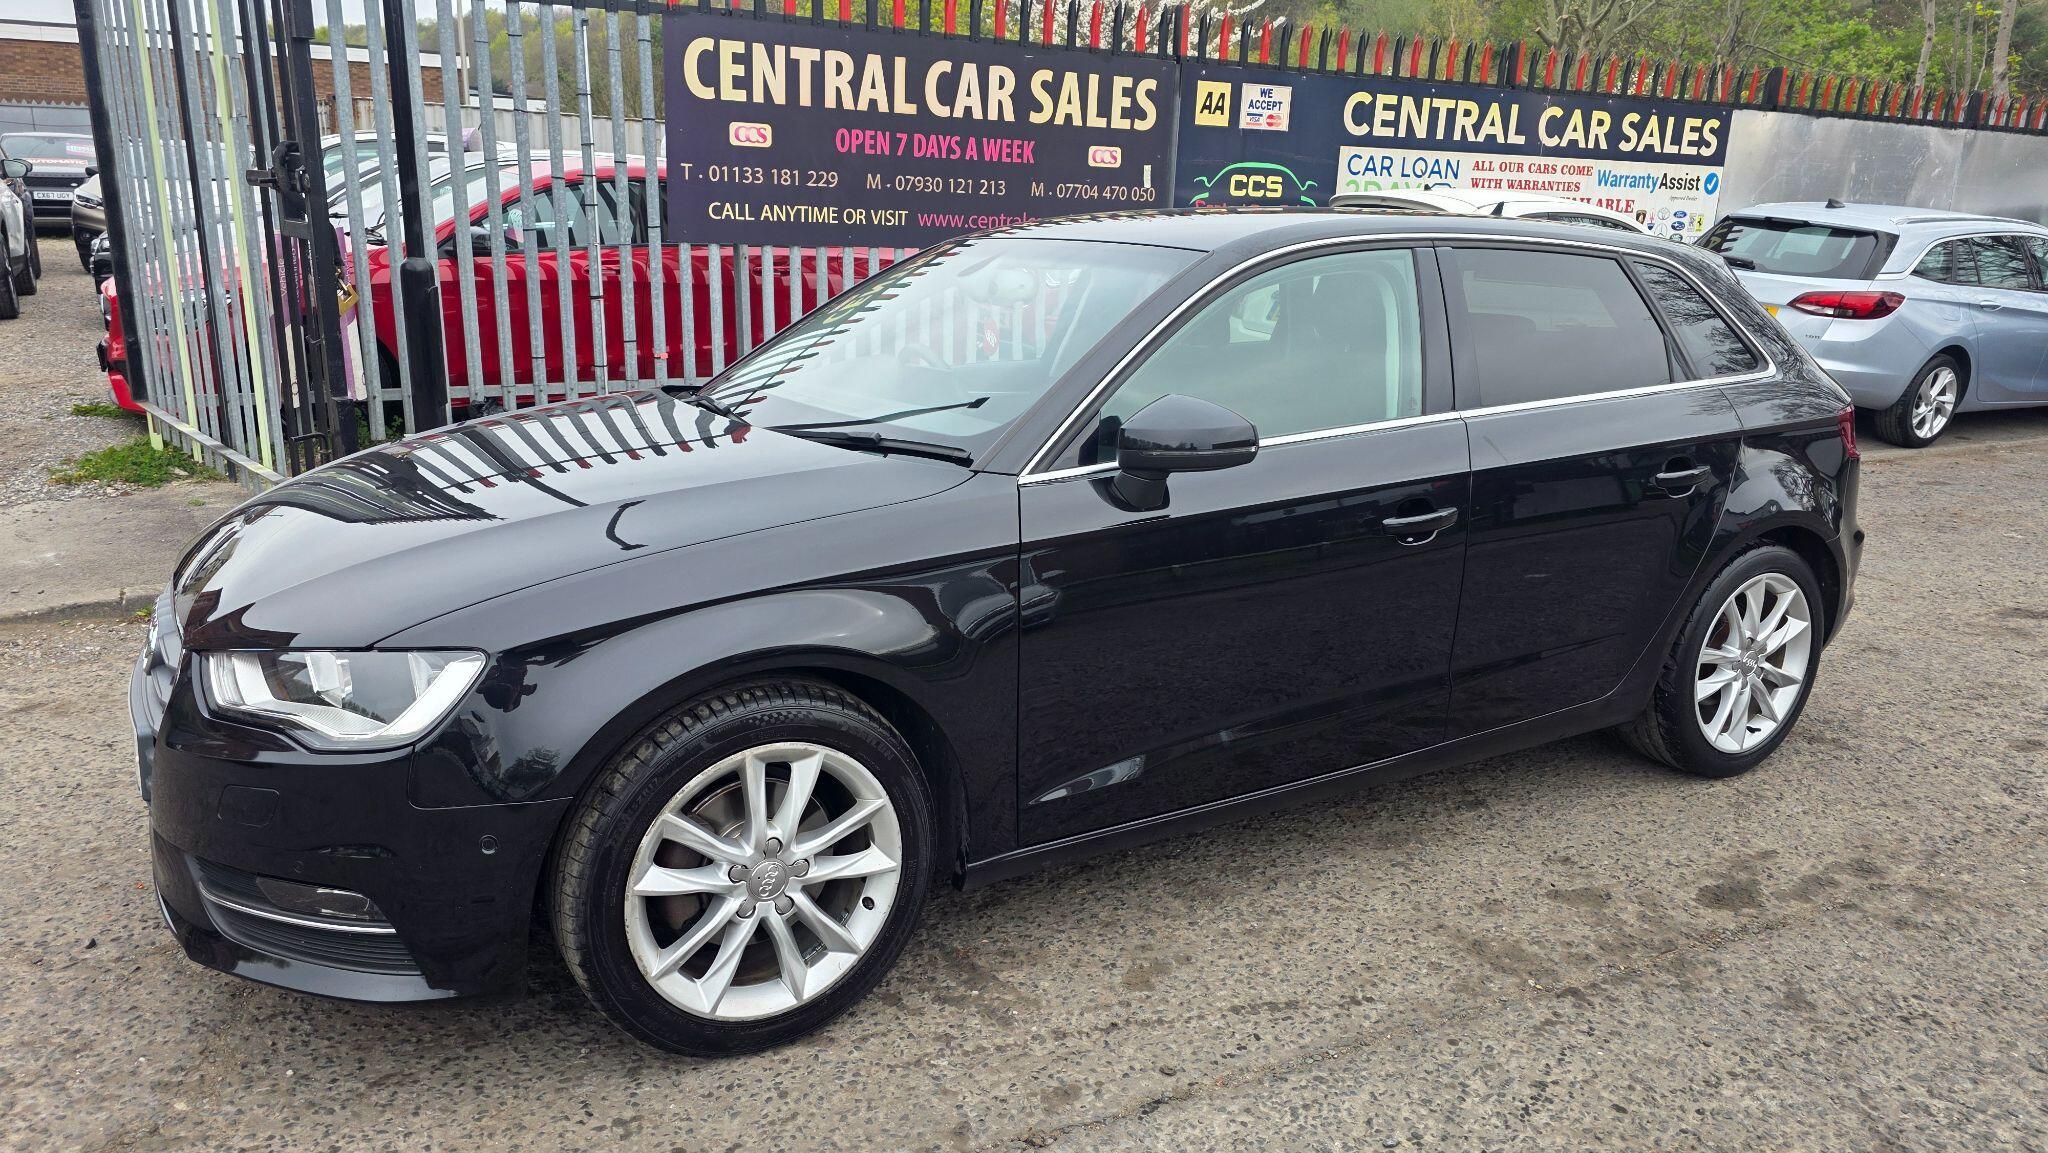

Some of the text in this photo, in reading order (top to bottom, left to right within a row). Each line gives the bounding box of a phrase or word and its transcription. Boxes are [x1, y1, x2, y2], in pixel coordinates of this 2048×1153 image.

[684, 36, 1157, 131] CENTRAL CAR SALES
[1260, 87, 1273, 99] WE
[1200, 91, 1226, 115] AA
[1248, 99, 1283, 112] ACCEPT
[1343, 91, 1721, 157] CENTRAL CAR SALES
[835, 128, 1035, 164] OPEN 7 DAYS A WEEK
[708, 164, 764, 184] 01133
[771, 168, 799, 186] 181
[806, 170, 839, 188] 229
[1347, 153, 1460, 180] CAR LOAN
[1472, 160, 1594, 177] ALL OUR CARS COME
[895, 175, 943, 193] 07930
[948, 178, 973, 194] 121
[979, 179, 1006, 196] 213
[1056, 183, 1099, 200] 07704
[1102, 185, 1128, 201] 470
[1131, 186, 1156, 202] 050
[1229, 174, 1283, 198] CCS
[1471, 177, 1581, 192] WITH WARRANTIES
[1597, 169, 1701, 194] WarrantyAssist
[708, 202, 755, 221] CALL
[760, 204, 839, 224] ANYTIME
[843, 208, 866, 225] OR
[870, 210, 909, 226] VISIT
